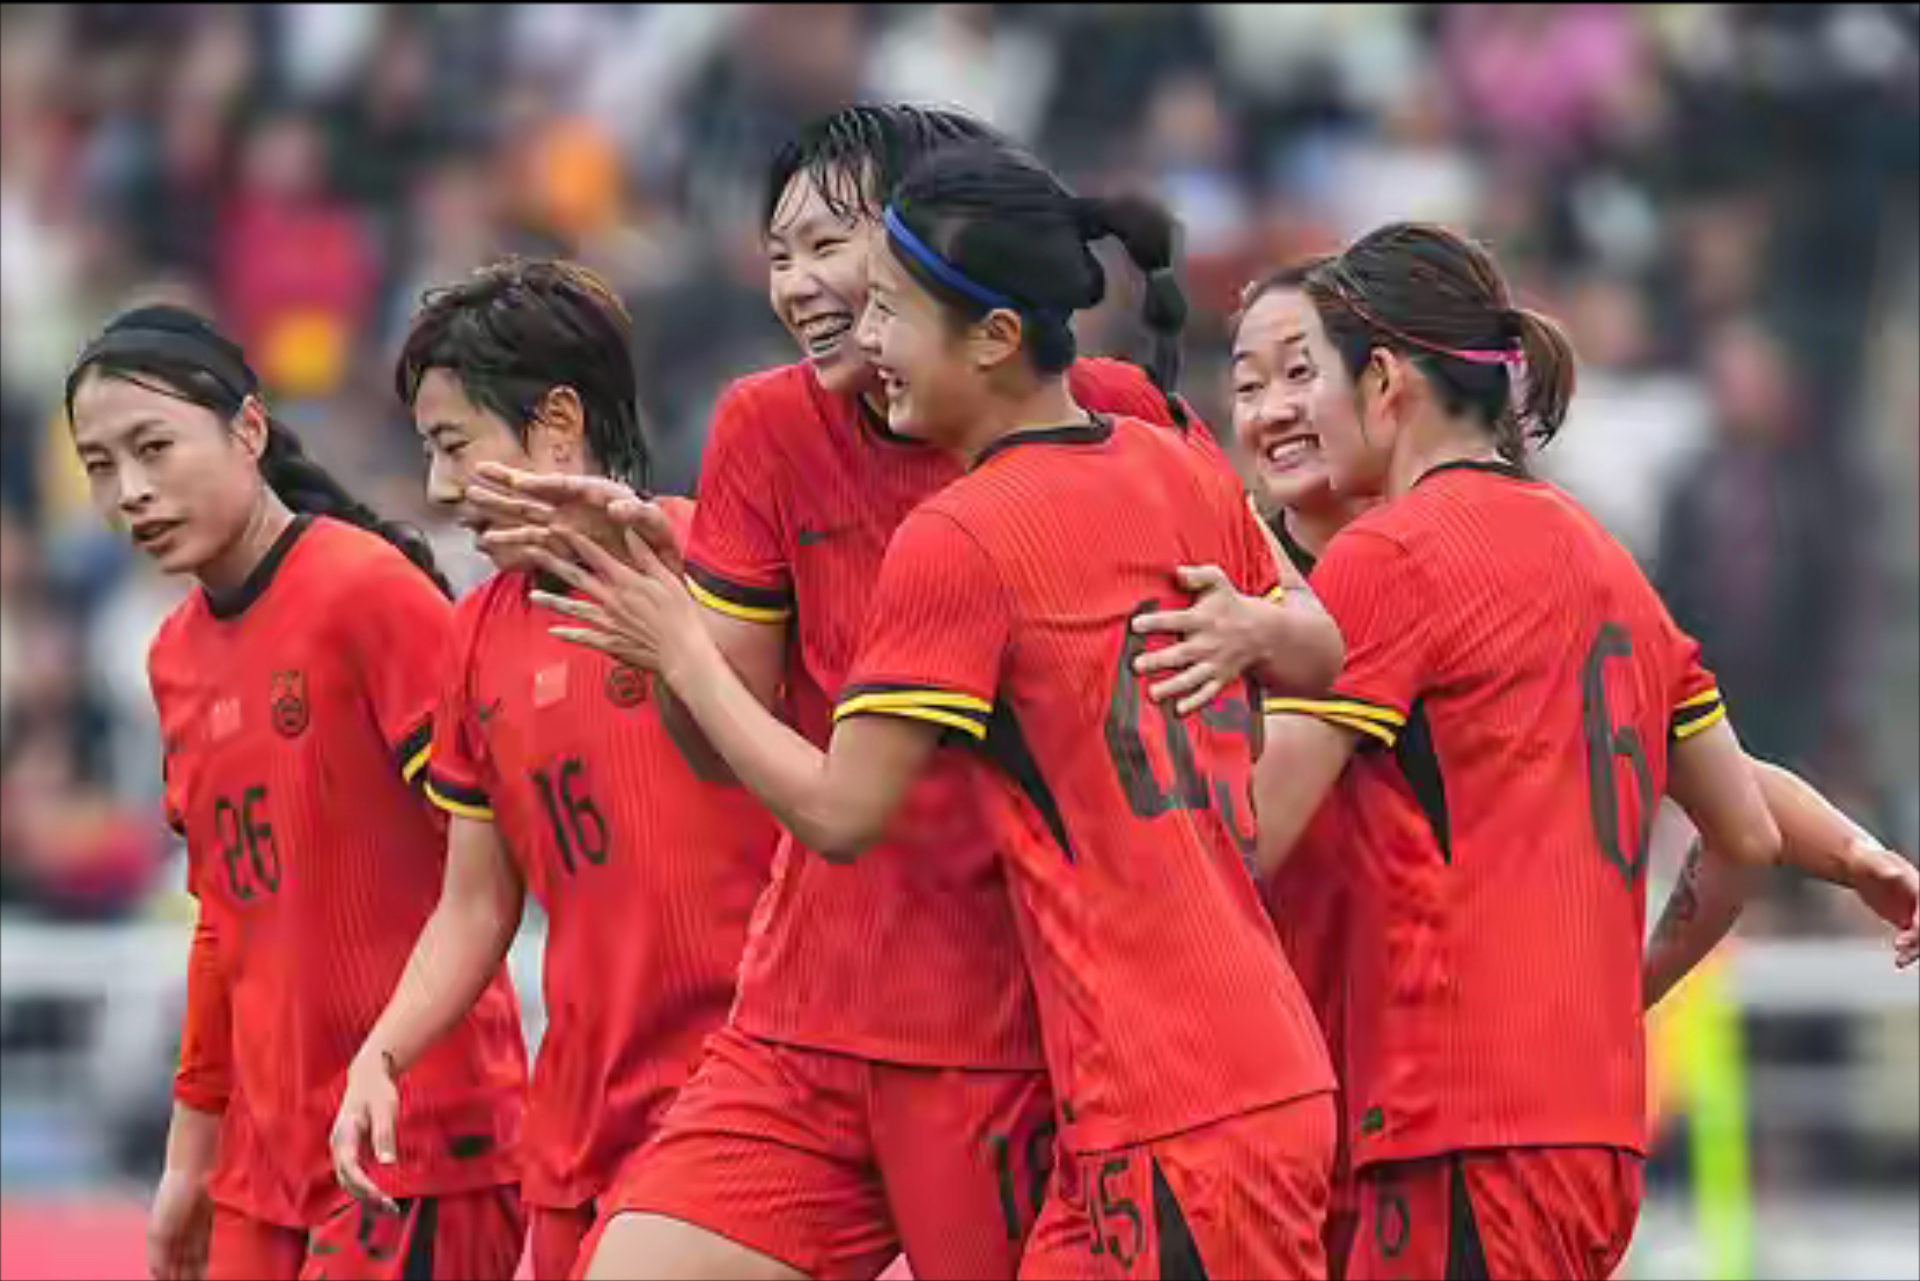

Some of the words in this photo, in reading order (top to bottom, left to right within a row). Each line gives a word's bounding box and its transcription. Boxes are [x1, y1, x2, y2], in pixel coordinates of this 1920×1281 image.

[1582, 621, 1652, 890] 6
[214, 786, 281, 901] 26
[532, 759, 609, 875] 16
[1084, 1158, 1146, 1270] 15
